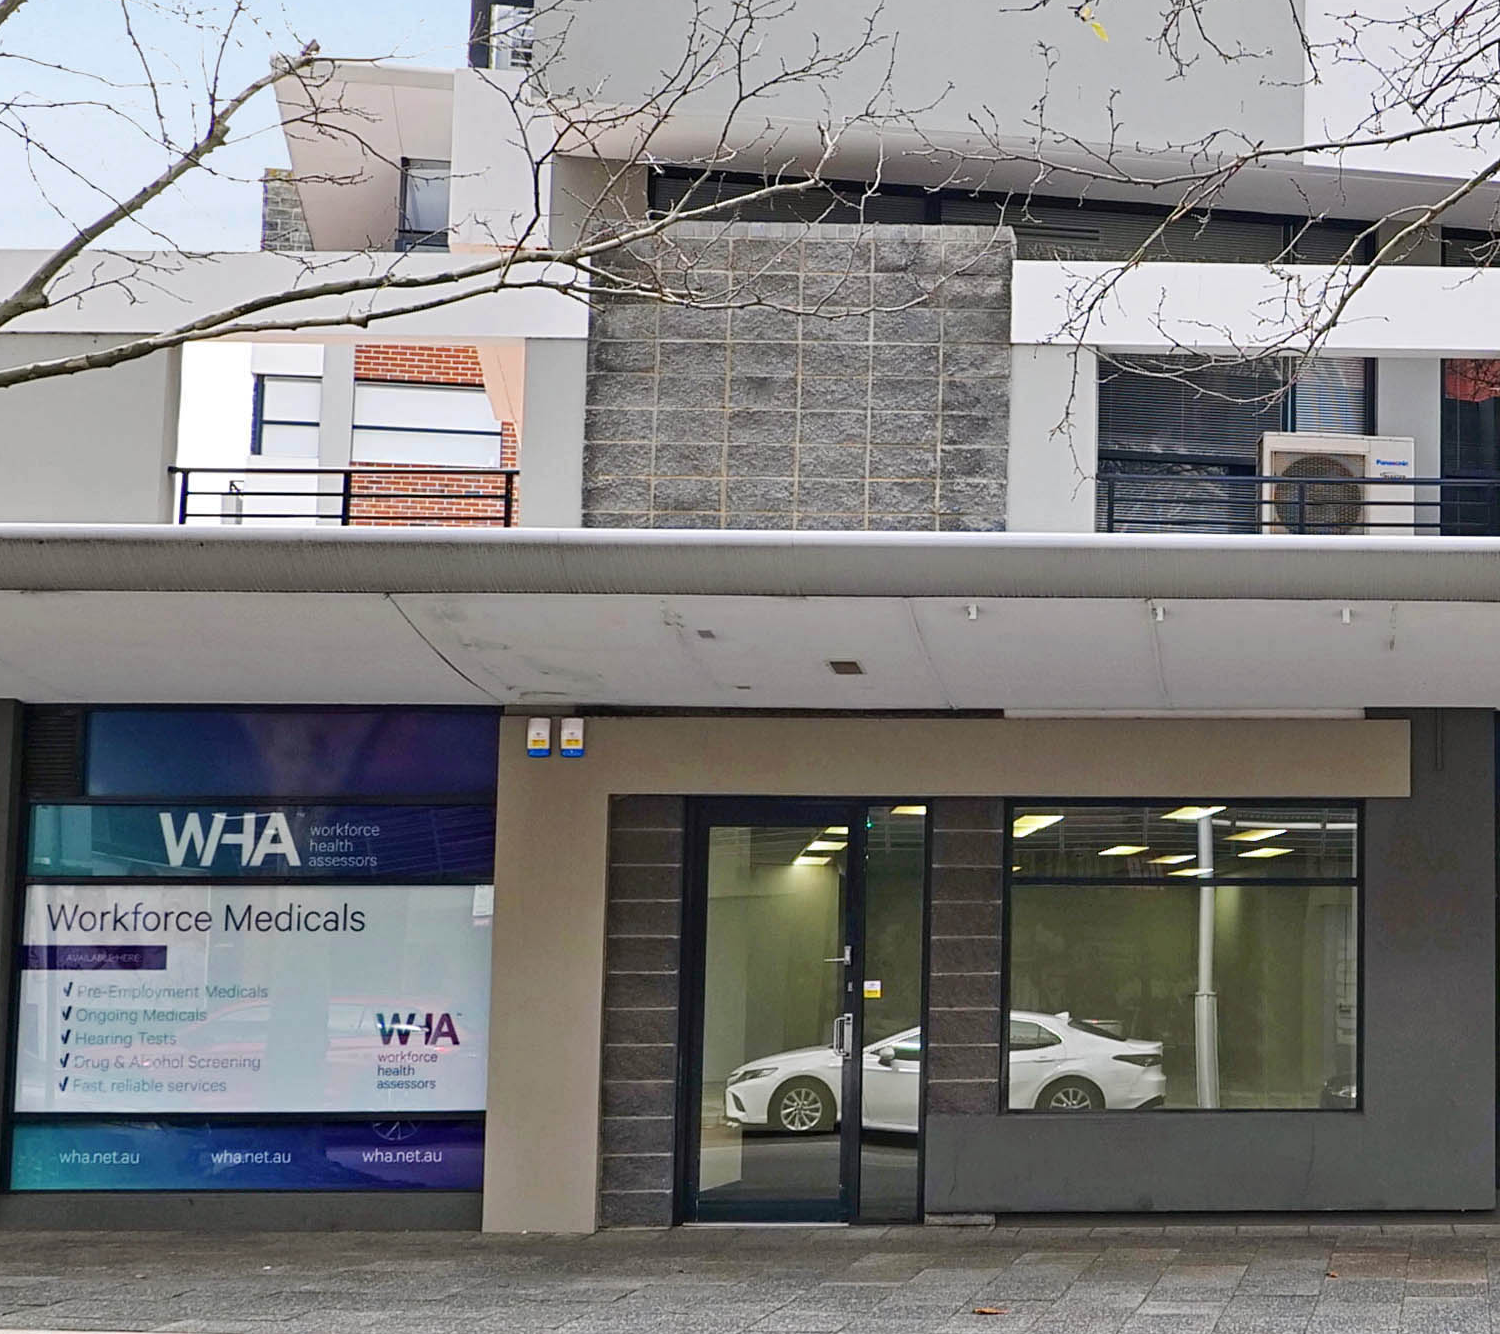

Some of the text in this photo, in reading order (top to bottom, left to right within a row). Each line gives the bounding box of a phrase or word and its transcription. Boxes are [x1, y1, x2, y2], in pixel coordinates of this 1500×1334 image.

[309, 822, 381, 837] workforce
[159, 812, 301, 867] WHA
[309, 839, 354, 853] health
[308, 855, 378, 867] assessors
[47, 902, 366, 932] Workforce Medicals
[78, 984, 269, 1000] Pre-Employment Medicals
[76, 1007, 207, 1025] Ongoing Medicals
[75, 1031, 177, 1048] Hearing Tests
[74, 1056, 109, 1072] Drug
[114, 1056, 124, 1068] &
[188, 1054, 261, 1071] Screening
[378, 1051, 438, 1063] workforce
[377, 1065, 415, 1076] health
[111, 1078, 163, 1092] reliable
[168, 1079, 227, 1092] services
[376, 1079, 436, 1089] assessors
[59, 1150, 140, 1165] wha.net.au
[211, 1150, 292, 1165] wha.net.au
[362, 1149, 443, 1164] wha.net.au
